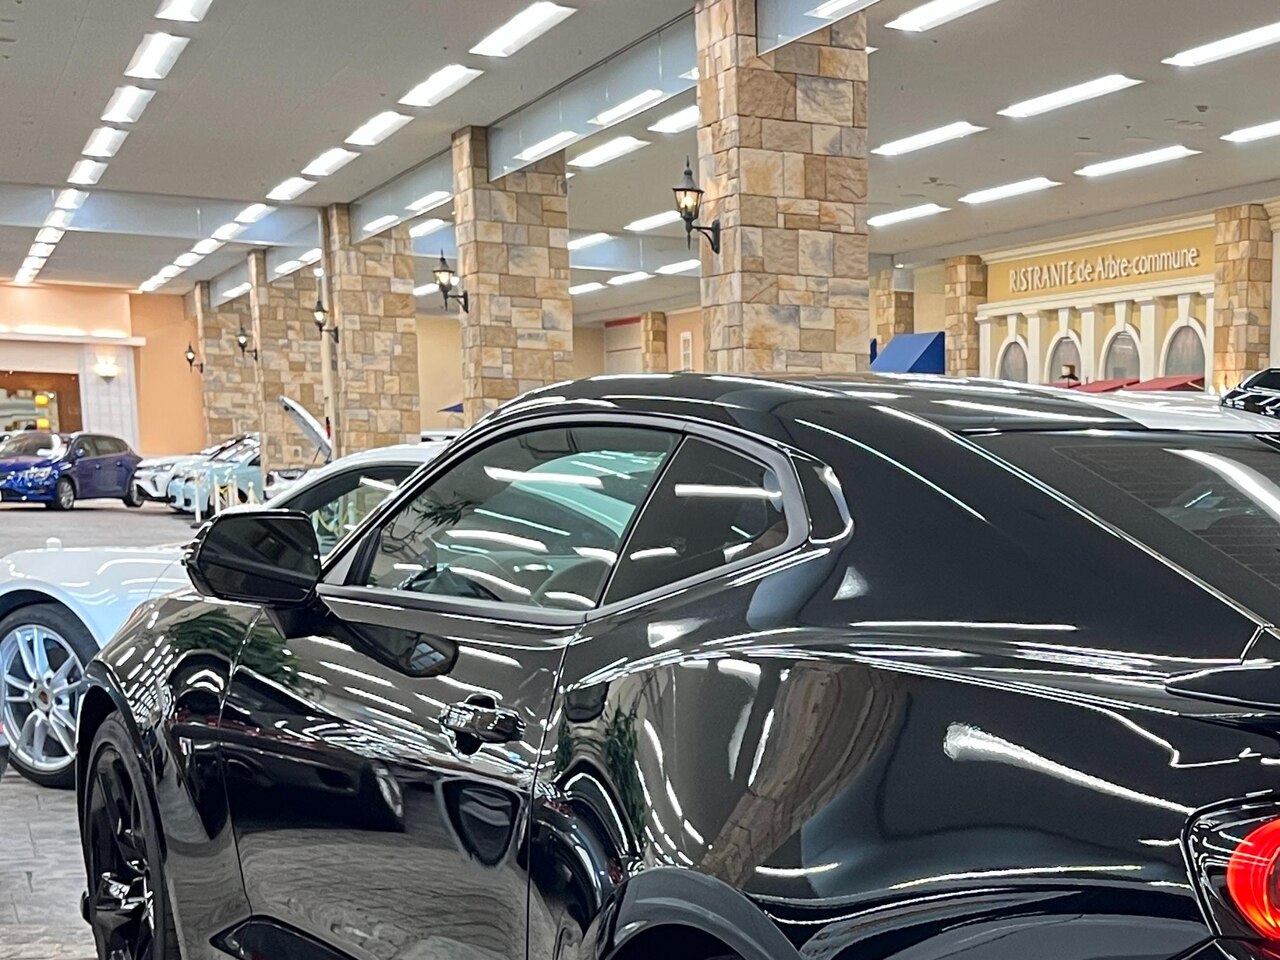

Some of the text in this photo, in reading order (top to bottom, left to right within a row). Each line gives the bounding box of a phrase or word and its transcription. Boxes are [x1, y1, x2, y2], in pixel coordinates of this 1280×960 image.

[1009, 247, 1200, 293] RISTRANTE de Arbre-commune
